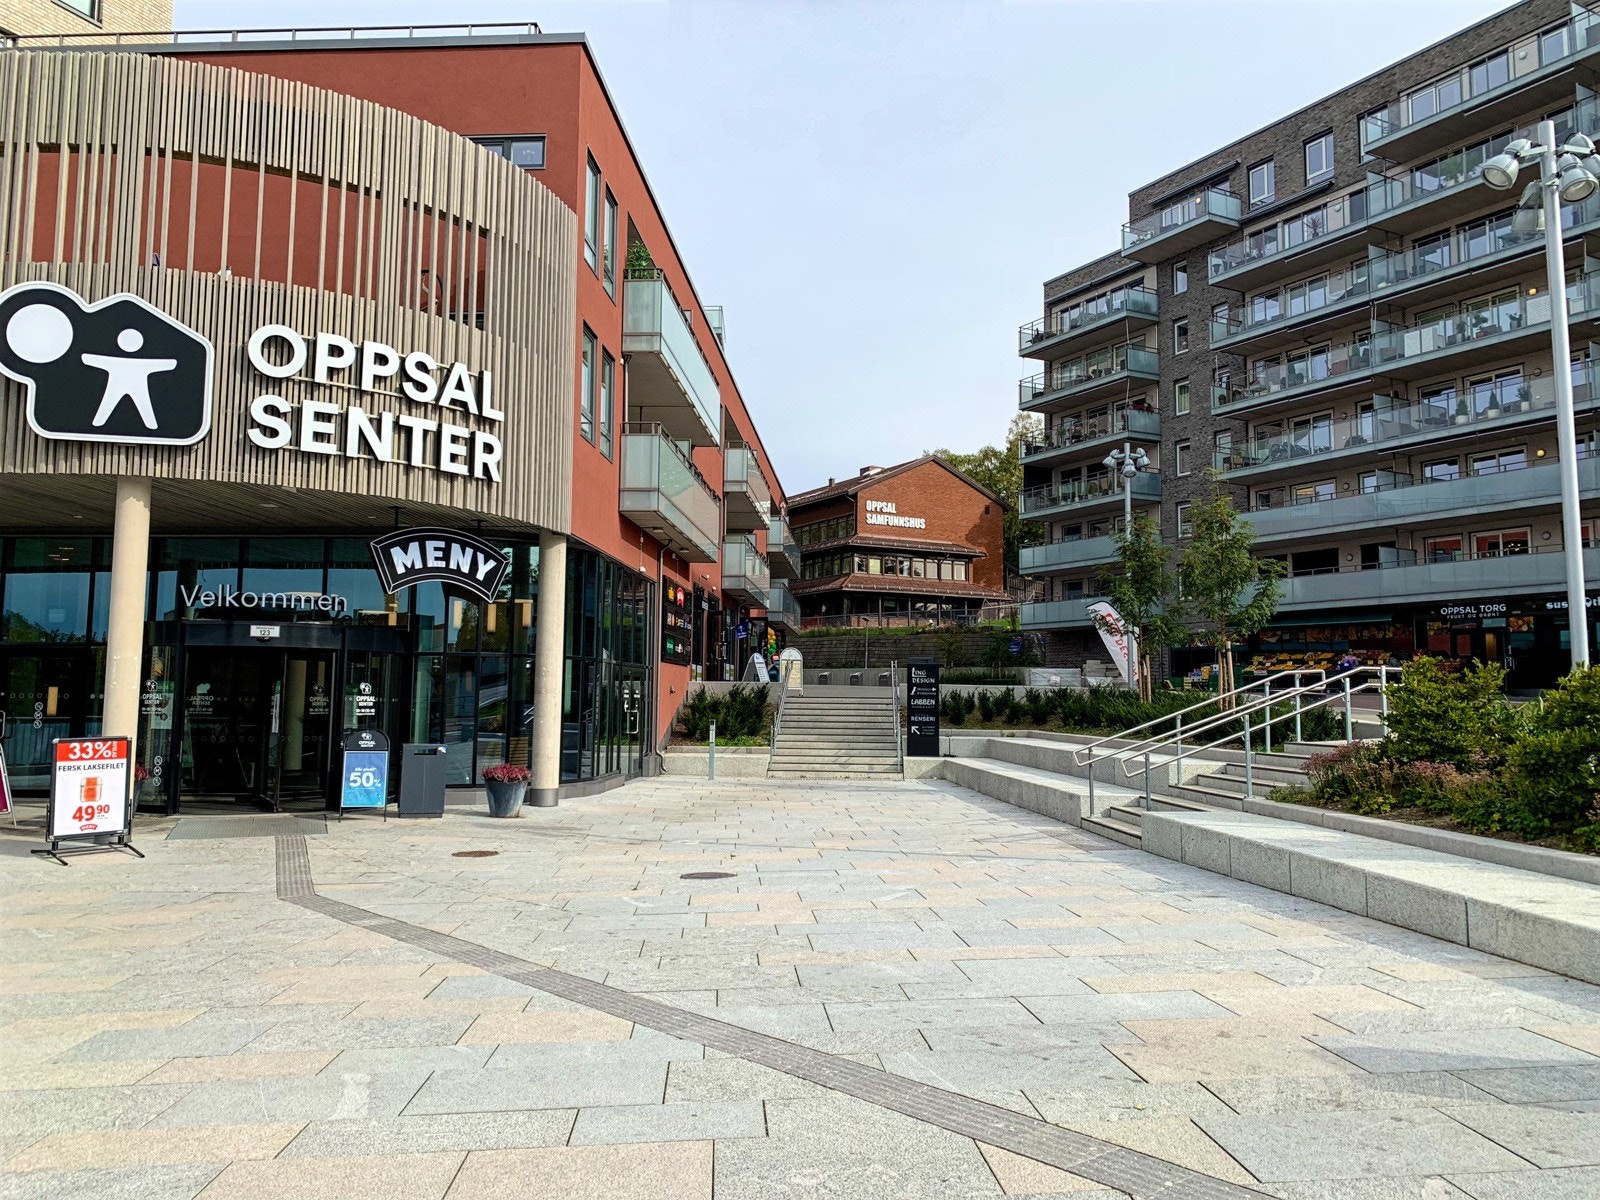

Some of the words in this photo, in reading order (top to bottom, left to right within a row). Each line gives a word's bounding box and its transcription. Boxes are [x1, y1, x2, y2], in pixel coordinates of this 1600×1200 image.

[248, 323, 504, 422] OPPSAL
[247, 394, 502, 483] SENTER
[866, 500, 896, 513] OPPSAL
[866, 513, 926, 528] SAMFUNNSHUS
[390, 540, 498, 582] MENY
[179, 583, 347, 612] Velkommen
[1440, 606, 1477, 615] OPPSAL
[1479, 604, 1506, 612] TORG
[68, 741, 112, 759] 33%
[83, 763, 124, 771] LAKSEFILET
[349, 772, 381, 788] 50%
[72, 805, 95, 822] 49
[96, 804, 110, 814] 90
